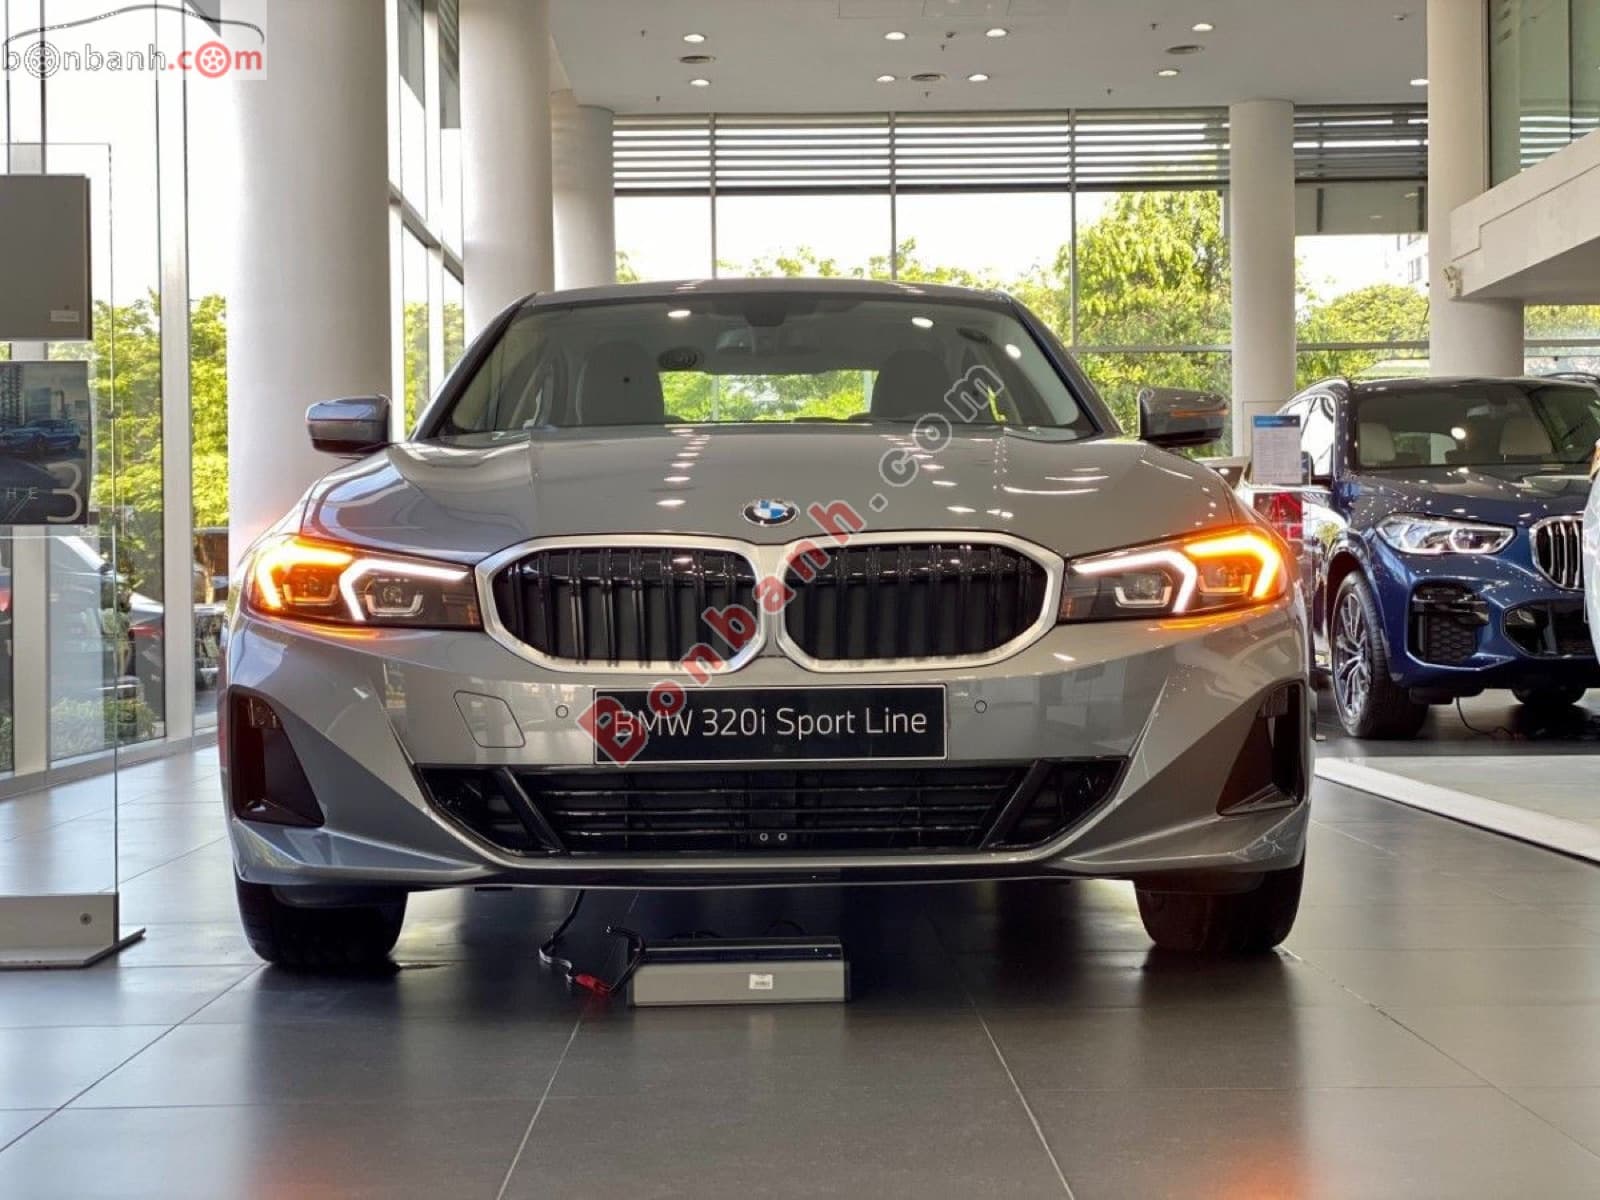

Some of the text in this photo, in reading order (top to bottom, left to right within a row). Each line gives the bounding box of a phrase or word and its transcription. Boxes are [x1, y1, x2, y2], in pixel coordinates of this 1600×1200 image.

[46, 461, 83, 523] 3
[613, 706, 928, 741] BMW 320i Sport Line
